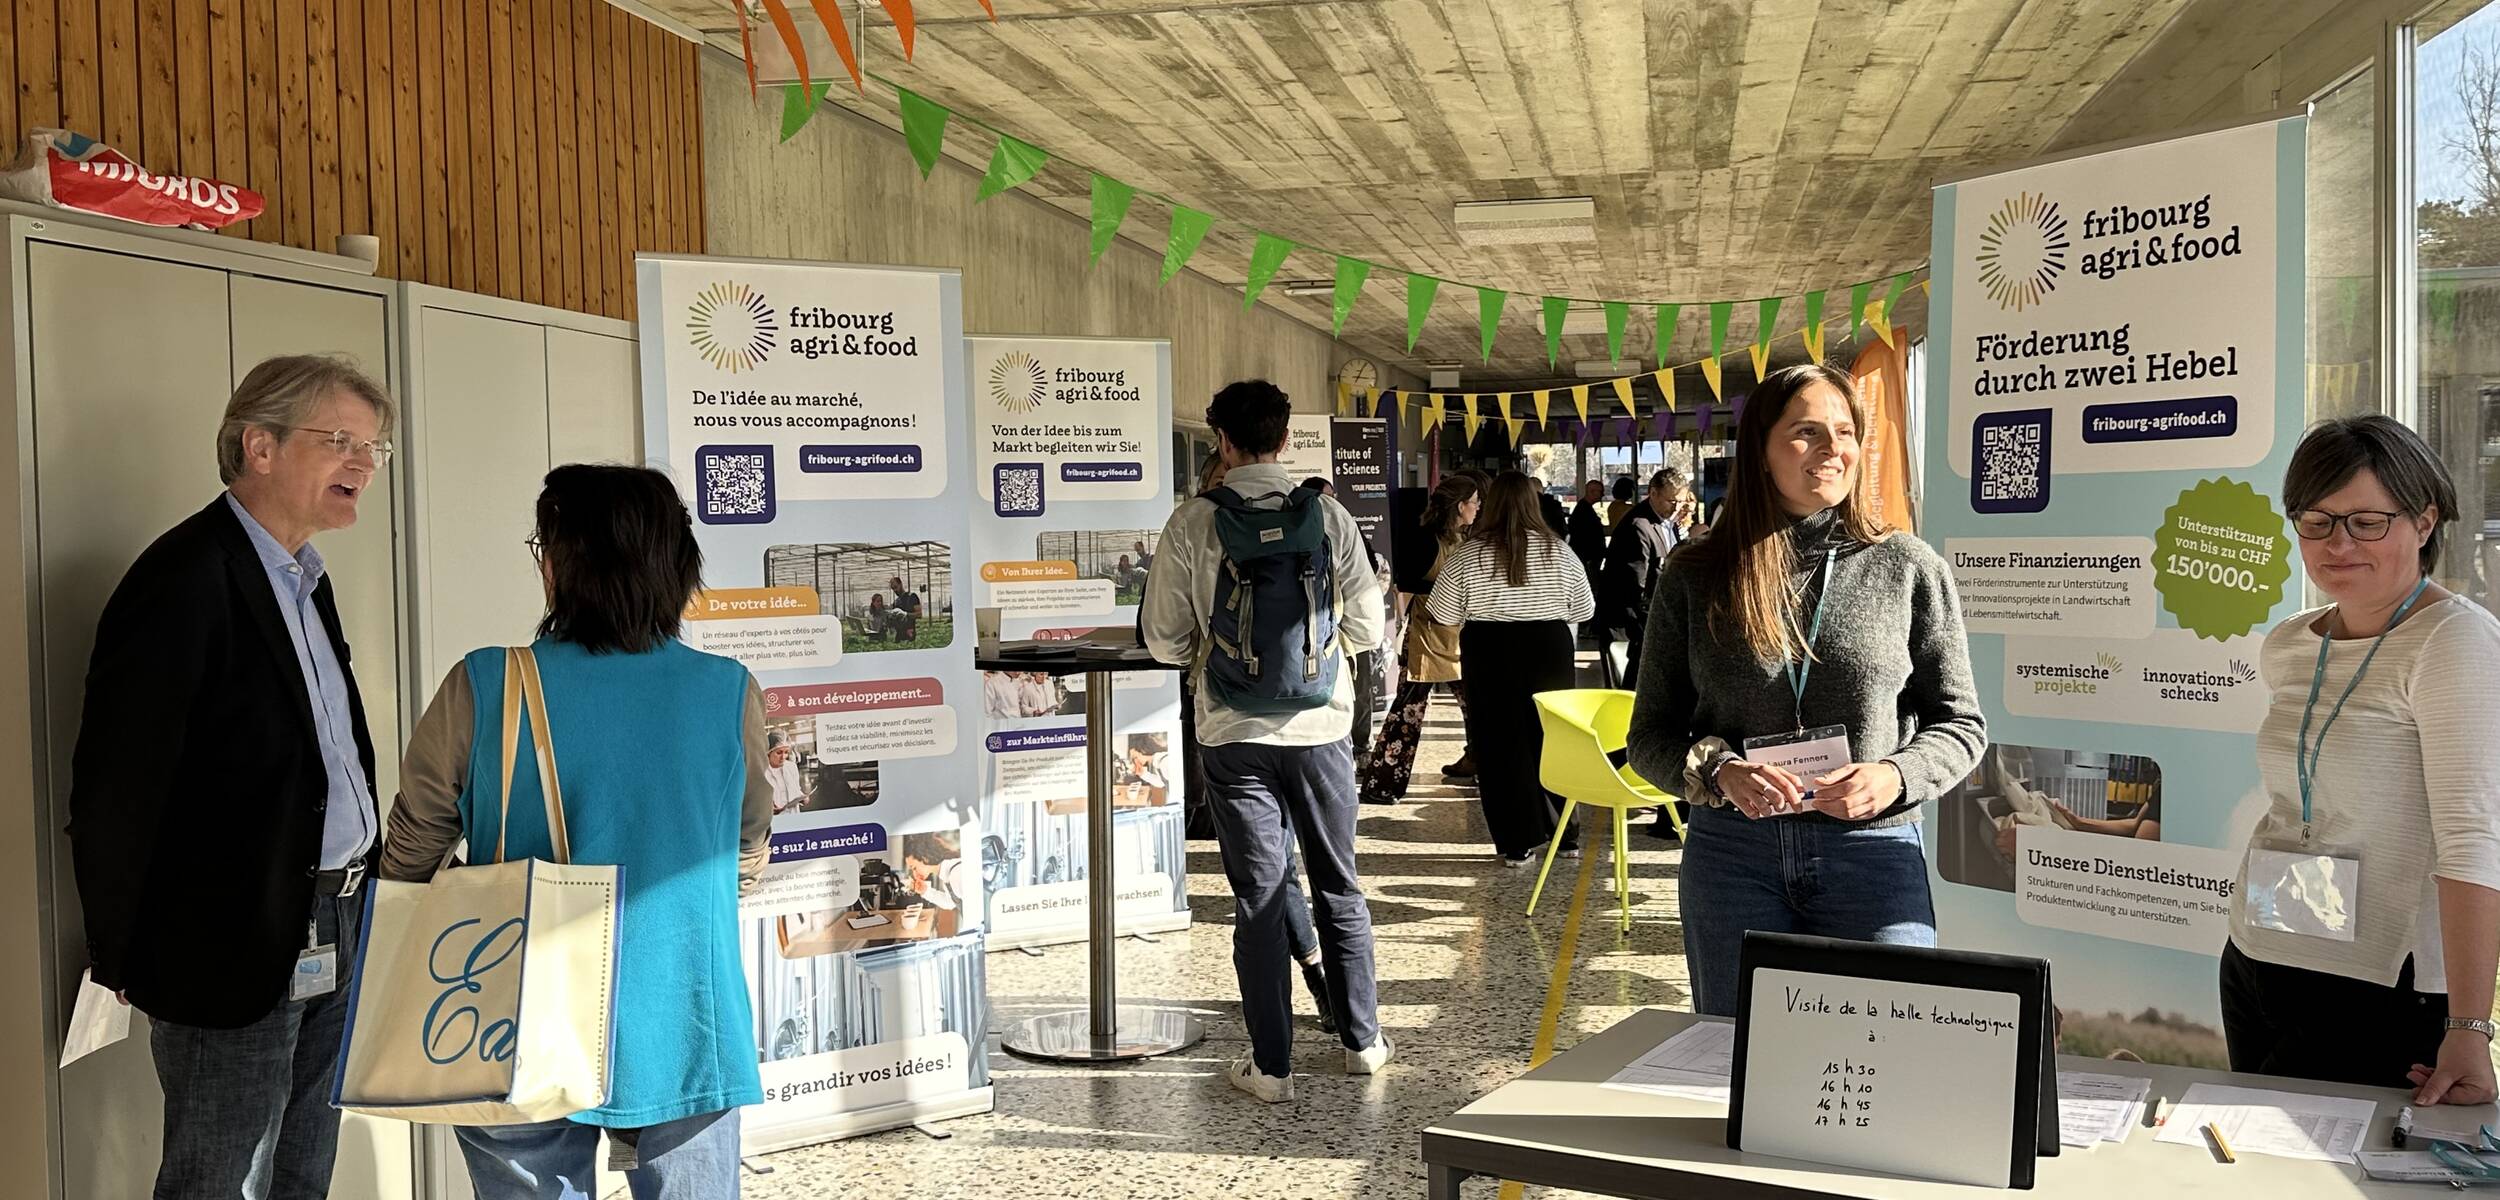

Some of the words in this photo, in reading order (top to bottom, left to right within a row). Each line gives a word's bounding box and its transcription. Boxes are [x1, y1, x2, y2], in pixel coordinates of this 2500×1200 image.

[2083, 194, 2211, 239] fribourg
[790, 307, 894, 334] fribourg
[1975, 323, 2130, 363] Förderung
[1055, 368, 1125, 386] fribourg
[1974, 365, 2057, 397] durch
[2065, 355, 2137, 389] zwei
[2146, 347, 2238, 383] Hebel
[692, 390, 716, 406] De
[720, 390, 766, 406] l'idée
[770, 395, 791, 406] au
[795, 393, 863, 409] marché,
[694, 415, 737, 428] nous
[741, 415, 782, 428] vous
[992, 424, 1018, 436] Von
[1021, 425, 1041, 436] der
[1044, 425, 1071, 436] Idee
[1074, 425, 1092, 436] bis
[1095, 428, 1122, 436] zum
[2093, 410, 2226, 433] fribourg-agrifood.ch
[992, 442, 1032, 453] Markt
[1036, 441, 1093, 455] begleiten
[1096, 442, 1116, 453] wir
[1120, 441, 1142, 453] Sie!
[1362, 447, 1372, 460] of
[808, 454, 914, 467] fribourg-agrifood.ch
[1343, 462, 1380, 475] Sciences
[1066, 468, 1138, 478] fribourg-agrifood.ch
[2177, 516, 2275, 550] Unterstützung
[2175, 535, 2198, 552] von
[2200, 538, 2218, 556] bis
[2220, 545, 2236, 558] zu
[2239, 546, 2272, 567] CHF
[1954, 552, 2006, 570] Unsere
[2009, 552, 2142, 572] Finanzierungen
[1002, 568, 1020, 577] Von
[1021, 567, 1044, 576] Ihrer
[1973, 577, 2046, 588] Förderinstrumente
[2047, 580, 2062, 588] zur
[2063, 579, 2128, 592] Unterstützung
[710, 599, 728, 612] De
[731, 598, 768, 612] votre
[1972, 594, 2051, 606] Innovationsprojekte
[2052, 596, 2061, 604] in
[2062, 594, 2131, 607] Landwirtschaft
[1969, 609, 2063, 621] Lebensmittelwirtschaft.
[714, 631, 739, 639] réseau
[768, 640, 802, 648] structurer
[2016, 662, 2110, 680] systemische
[2143, 667, 2242, 688] innovations-
[2034, 679, 2097, 696] projekte
[2160, 685, 2220, 703] schecks
[788, 694, 796, 708] à
[799, 695, 822, 707] son
[1006, 738, 1022, 746] zur
[1022, 732, 1088, 745] Markteinführu
[782, 843, 804, 854] sur
[806, 840, 818, 851] le
[2027, 849, 2090, 875] Unsere
[2094, 857, 2235, 898] Dienstleistunge
[2026, 875, 2074, 892] Strukturen
[2076, 882, 2094, 895] und
[2095, 885, 2182, 910] Fachkompetenzen,
[2183, 900, 2198, 912] um
[2200, 901, 2215, 914] Sie
[1002, 903, 1039, 914] Lassen
[1042, 899, 1058, 909] Sie
[1060, 897, 1082, 908] Ihre
[2026, 891, 2116, 916] Produktentwicklung
[2118, 906, 2128, 918] zu
[2130, 906, 2192, 926] unterstützen.
[1785, 986, 1831, 1015] Visite
[1839, 1002, 1857, 1016] de
[1867, 1000, 1878, 1017] la
[1890, 999, 1923, 1021] halle
[1930, 1005, 2015, 1036] technologique
[1822, 1063, 1839, 1075] 15
[1845, 1058, 1854, 1074] h
[1858, 1064, 1876, 1076] 30
[780, 1072, 854, 1102] grandir
[858, 1067, 892, 1084] vos
[1820, 1080, 1835, 1092] 16
[1843, 1076, 1852, 1092] h
[1857, 1084, 1872, 1094] 10
[1816, 1098, 1830, 1110] 16
[1840, 1096, 1848, 1110] h
[1856, 1100, 1871, 1110] 45
[1814, 1115, 1828, 1126] 17
[1838, 1112, 1846, 1126] h
[1856, 1116, 1870, 1127] 25
